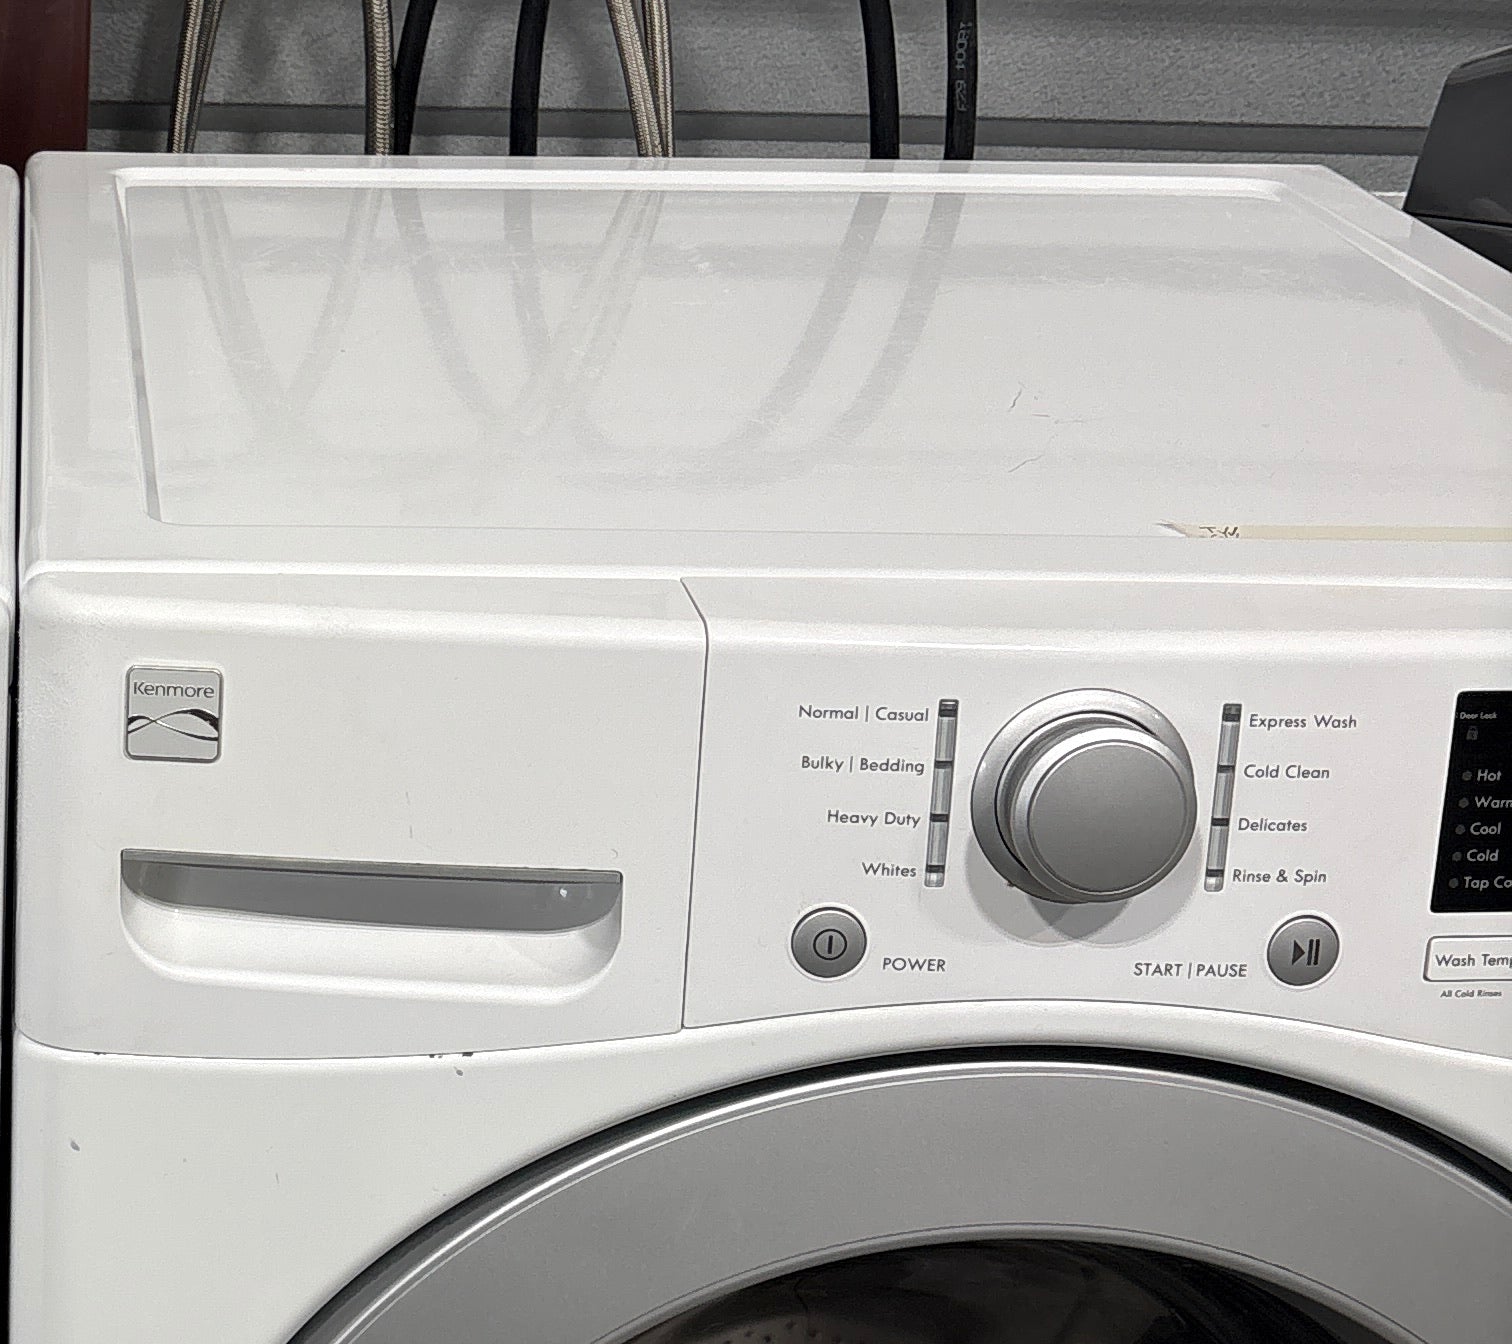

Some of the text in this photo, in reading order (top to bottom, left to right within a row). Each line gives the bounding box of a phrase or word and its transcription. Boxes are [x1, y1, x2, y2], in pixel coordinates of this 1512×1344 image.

[133, 681, 215, 699] Kenmore
[798, 704, 929, 722] Normal Casual
[1459, 711, 1498, 720] Door Lock
[1249, 713, 1357, 732] Express Wash
[801, 755, 925, 777] Bulky Bedding
[1243, 763, 1330, 779] Cold Clean
[1476, 768, 1502, 782] Hot
[827, 809, 921, 829] Heavy Duty
[1237, 817, 1308, 832] Delicates
[1469, 821, 1502, 836] Cool
[1466, 848, 1500, 862] Cold
[861, 861, 917, 878] Whites
[1232, 868, 1327, 887] Rinse & Spin
[1463, 875, 1490, 892] Tap
[882, 957, 946, 972] POWER
[1435, 953, 1512, 969] Wash Tem
[1133, 962, 1248, 978] START PAUSE
[1439, 989, 1503, 999] All Cold Rinses
